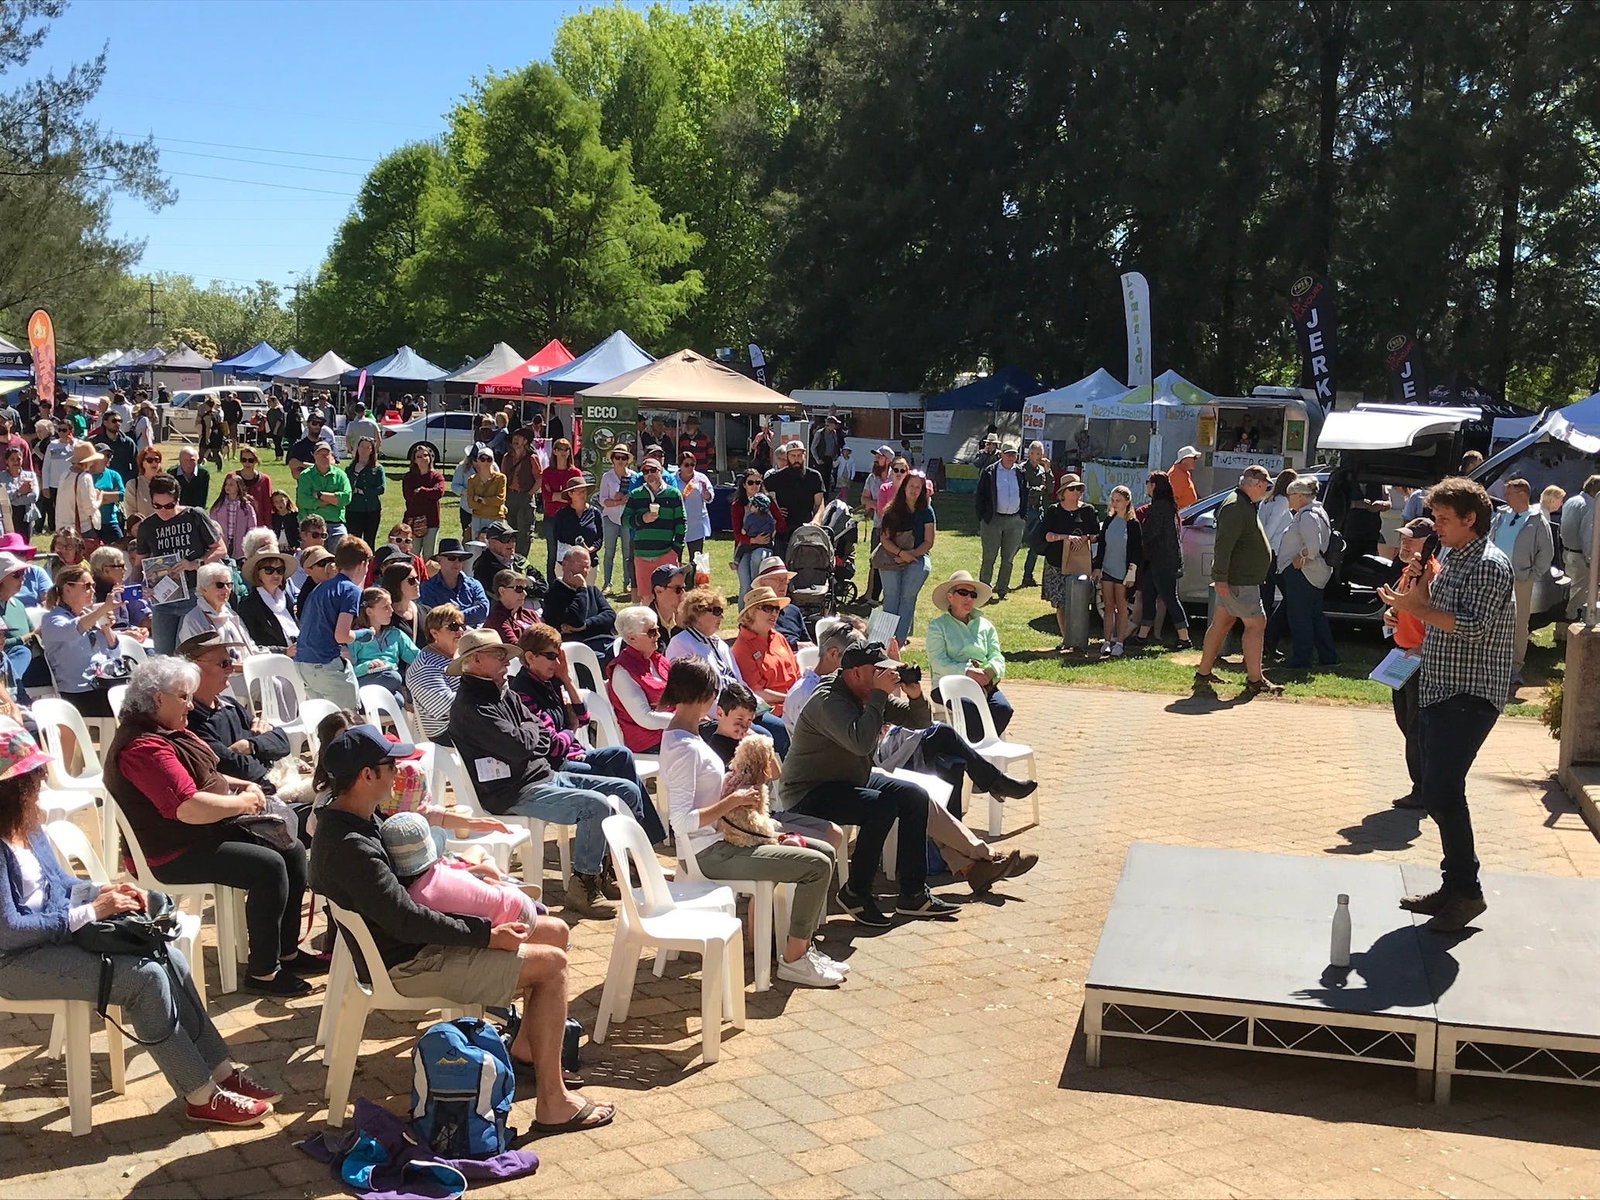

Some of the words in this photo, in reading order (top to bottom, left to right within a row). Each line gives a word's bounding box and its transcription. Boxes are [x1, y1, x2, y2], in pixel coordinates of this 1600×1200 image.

[1306, 308, 1332, 418] JERKY
[1400, 361, 1418, 406] JE
[587, 405, 618, 419] ECCO
[1023, 413, 1044, 428] Pies
[155, 522, 193, 539] SAMOYED
[157, 534, 191, 550] MOTHER
